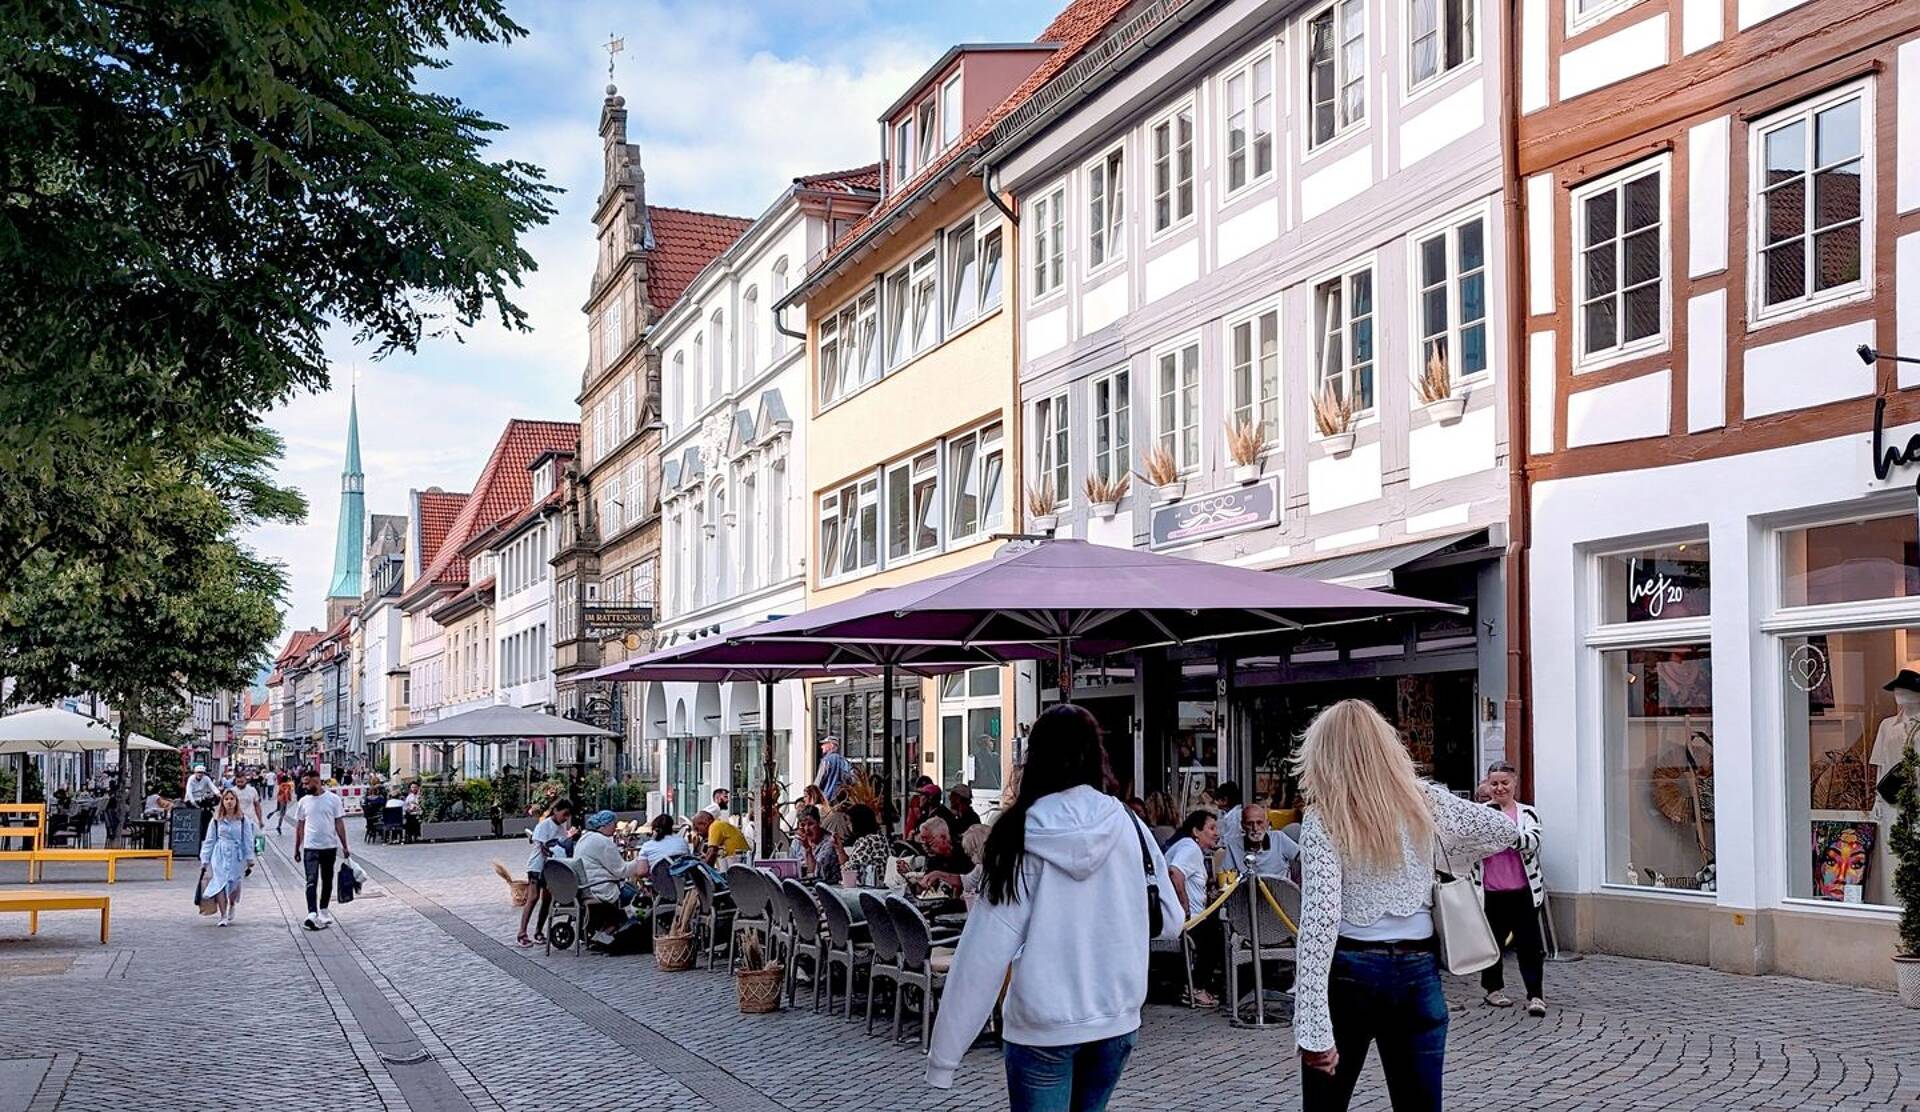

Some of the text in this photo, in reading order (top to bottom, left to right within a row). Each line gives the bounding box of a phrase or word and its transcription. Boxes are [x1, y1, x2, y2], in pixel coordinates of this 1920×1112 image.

[1630, 557, 1683, 617] hej 20
[1216, 679, 1227, 696] 19
